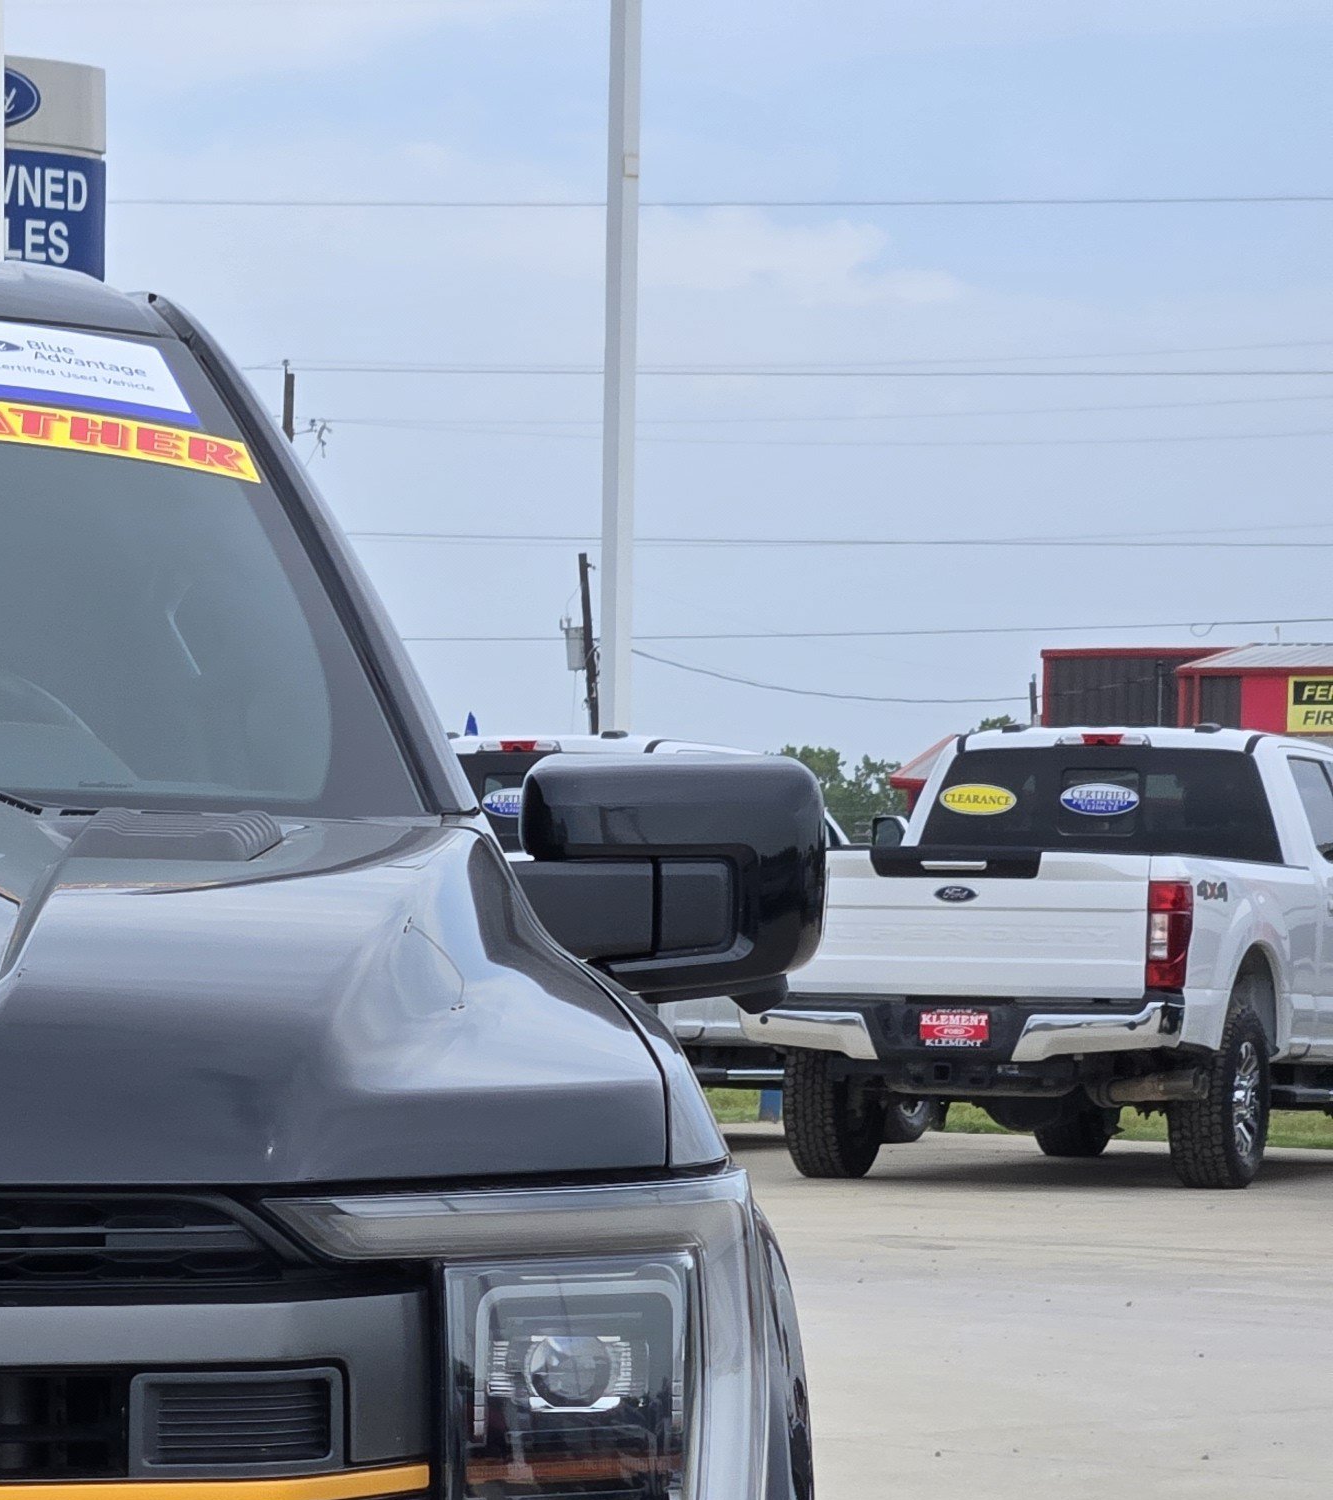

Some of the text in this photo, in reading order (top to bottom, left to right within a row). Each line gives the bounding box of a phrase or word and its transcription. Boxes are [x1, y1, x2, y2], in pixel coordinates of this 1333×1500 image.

[26, 340, 75, 355] Blue
[34, 351, 147, 378] Advantage
[60, 370, 98, 382] Used
[102, 375, 155, 392] Vehicle
[944, 793, 1011, 806] CLEARANCE
[1071, 789, 1130, 800] CERTIFIED
[943, 887, 969, 898] Ford
[920, 1013, 988, 1026] KLEMENT
[925, 1038, 983, 1047] KLEMENT
